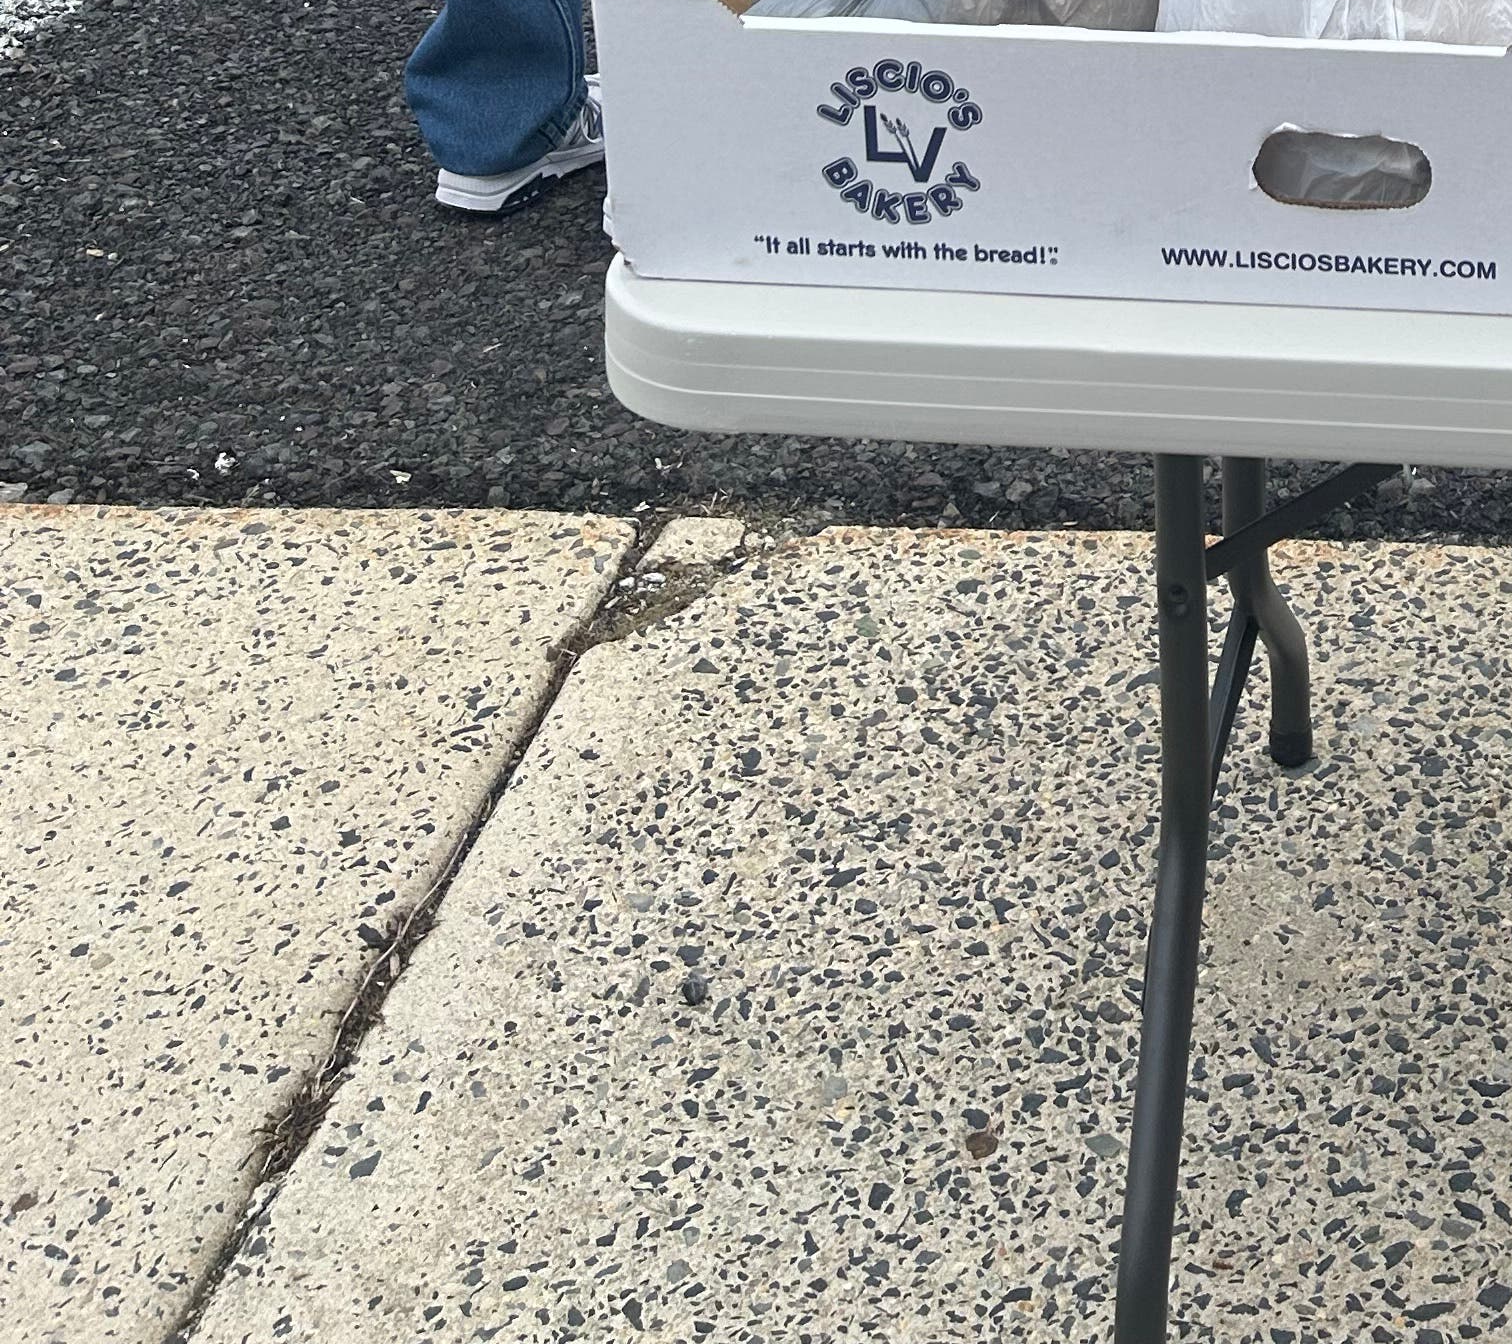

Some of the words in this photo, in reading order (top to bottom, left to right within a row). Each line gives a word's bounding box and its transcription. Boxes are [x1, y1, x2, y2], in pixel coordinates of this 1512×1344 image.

[817, 59, 983, 131] LISCIO'S
[822, 157, 981, 225] BAKERY
[786, 236, 811, 255] all
[817, 239, 876, 258] starts
[882, 241, 927, 260] with
[933, 243, 968, 262] the
[1161, 247, 1497, 280] WWW.LISCIOSBAKERY.COM
